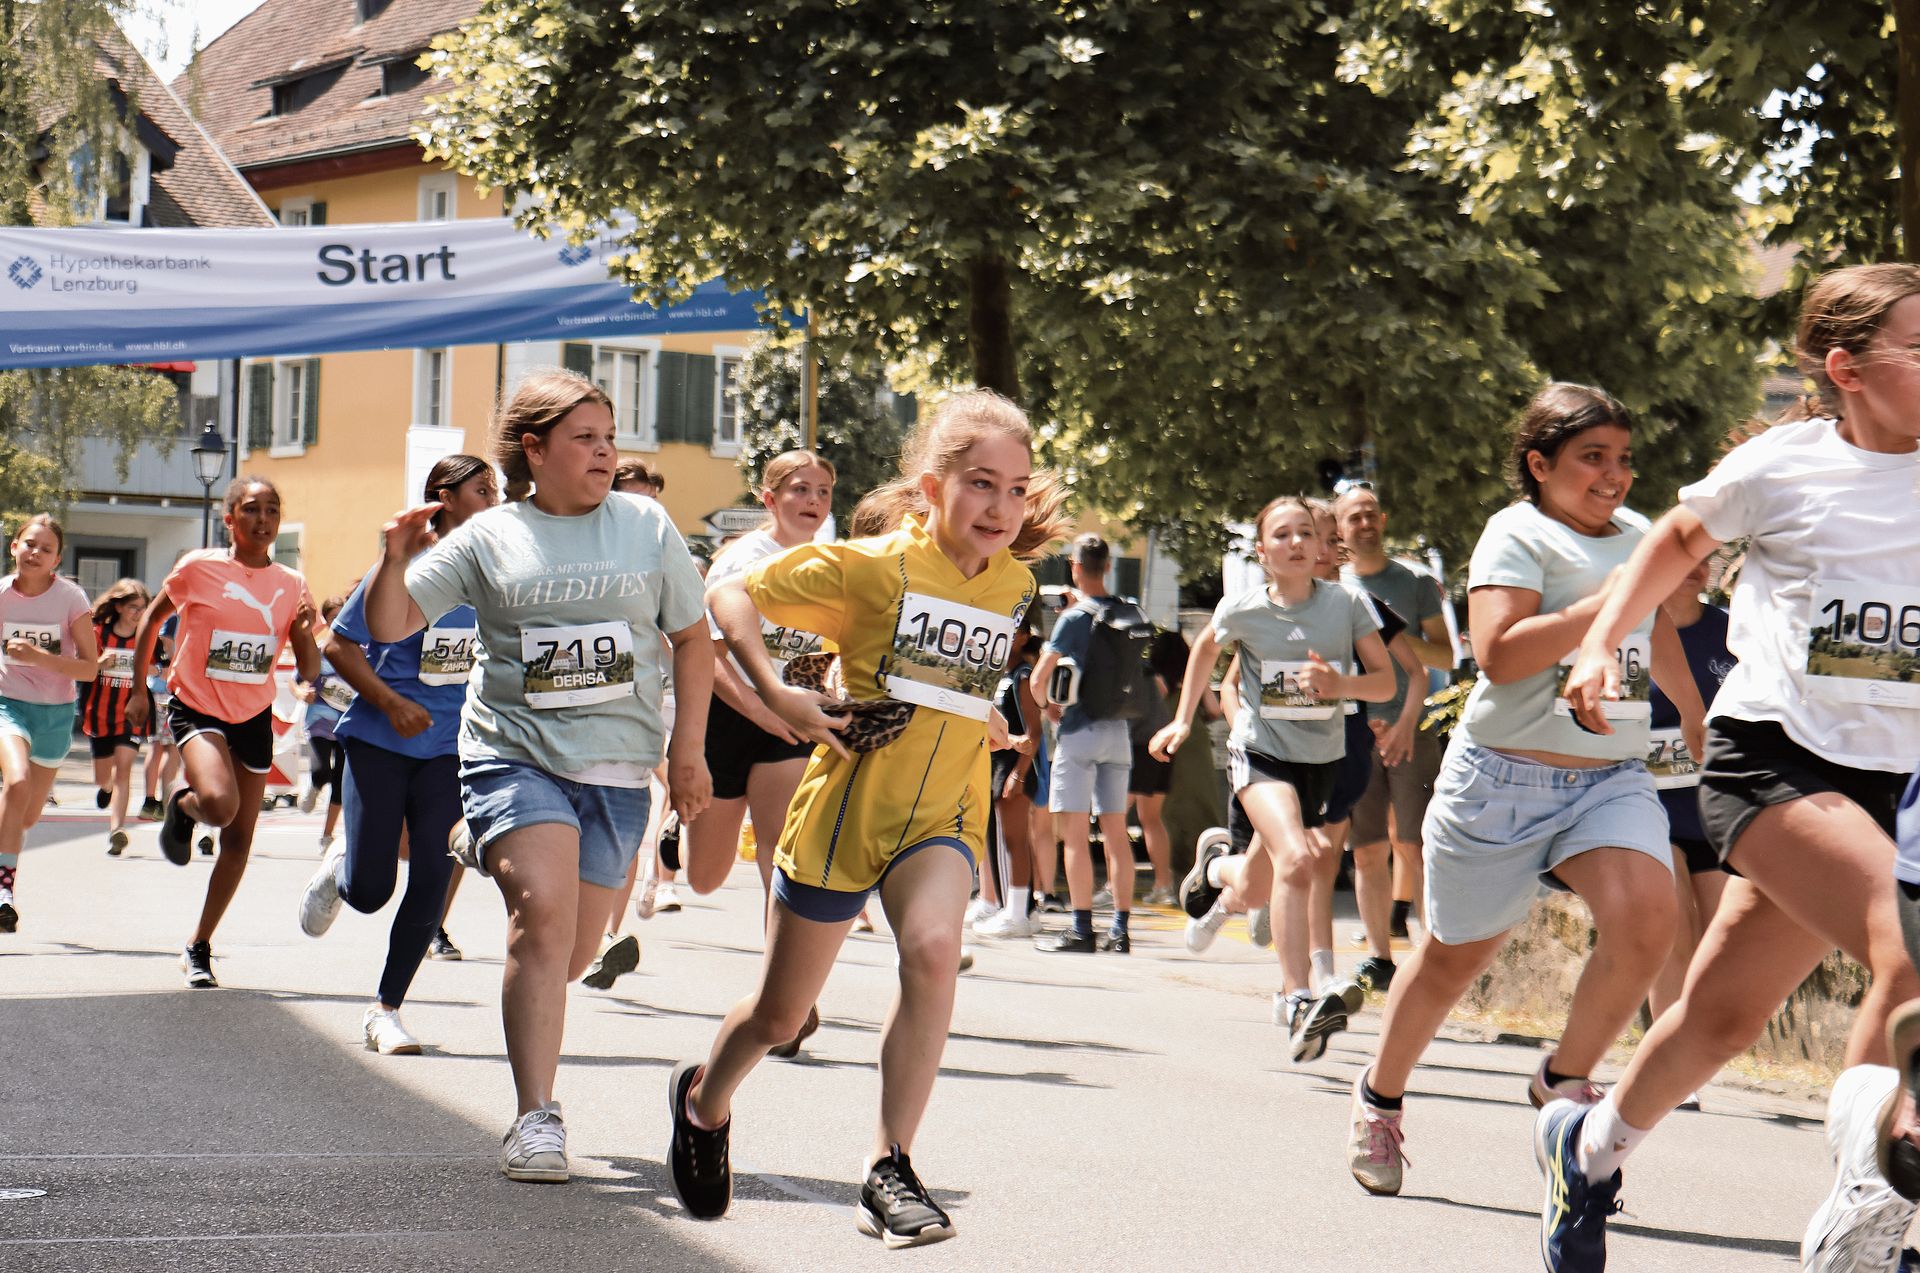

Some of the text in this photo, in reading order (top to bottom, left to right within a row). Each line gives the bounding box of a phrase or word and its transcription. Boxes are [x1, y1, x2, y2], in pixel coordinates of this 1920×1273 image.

[50, 254, 211, 273] Hypothekarbank
[317, 244, 456, 287] Start
[51, 276, 138, 294] Lenzburg
[557, 315, 607, 326] Vertrauen
[9, 344, 60, 353] Vertrauen
[576, 562, 592, 573] TO
[594, 560, 617, 571] THE
[499, 571, 648, 608] MALDIVES
[1821, 598, 1920, 648] 106
[910, 611, 1008, 670] 1030
[222, 640, 266, 663] 161
[537, 636, 617, 672] 719
[441, 661, 469, 672] ZAHRA
[553, 672, 607, 688] DERISA
[1285, 696, 1316, 706] JANA
